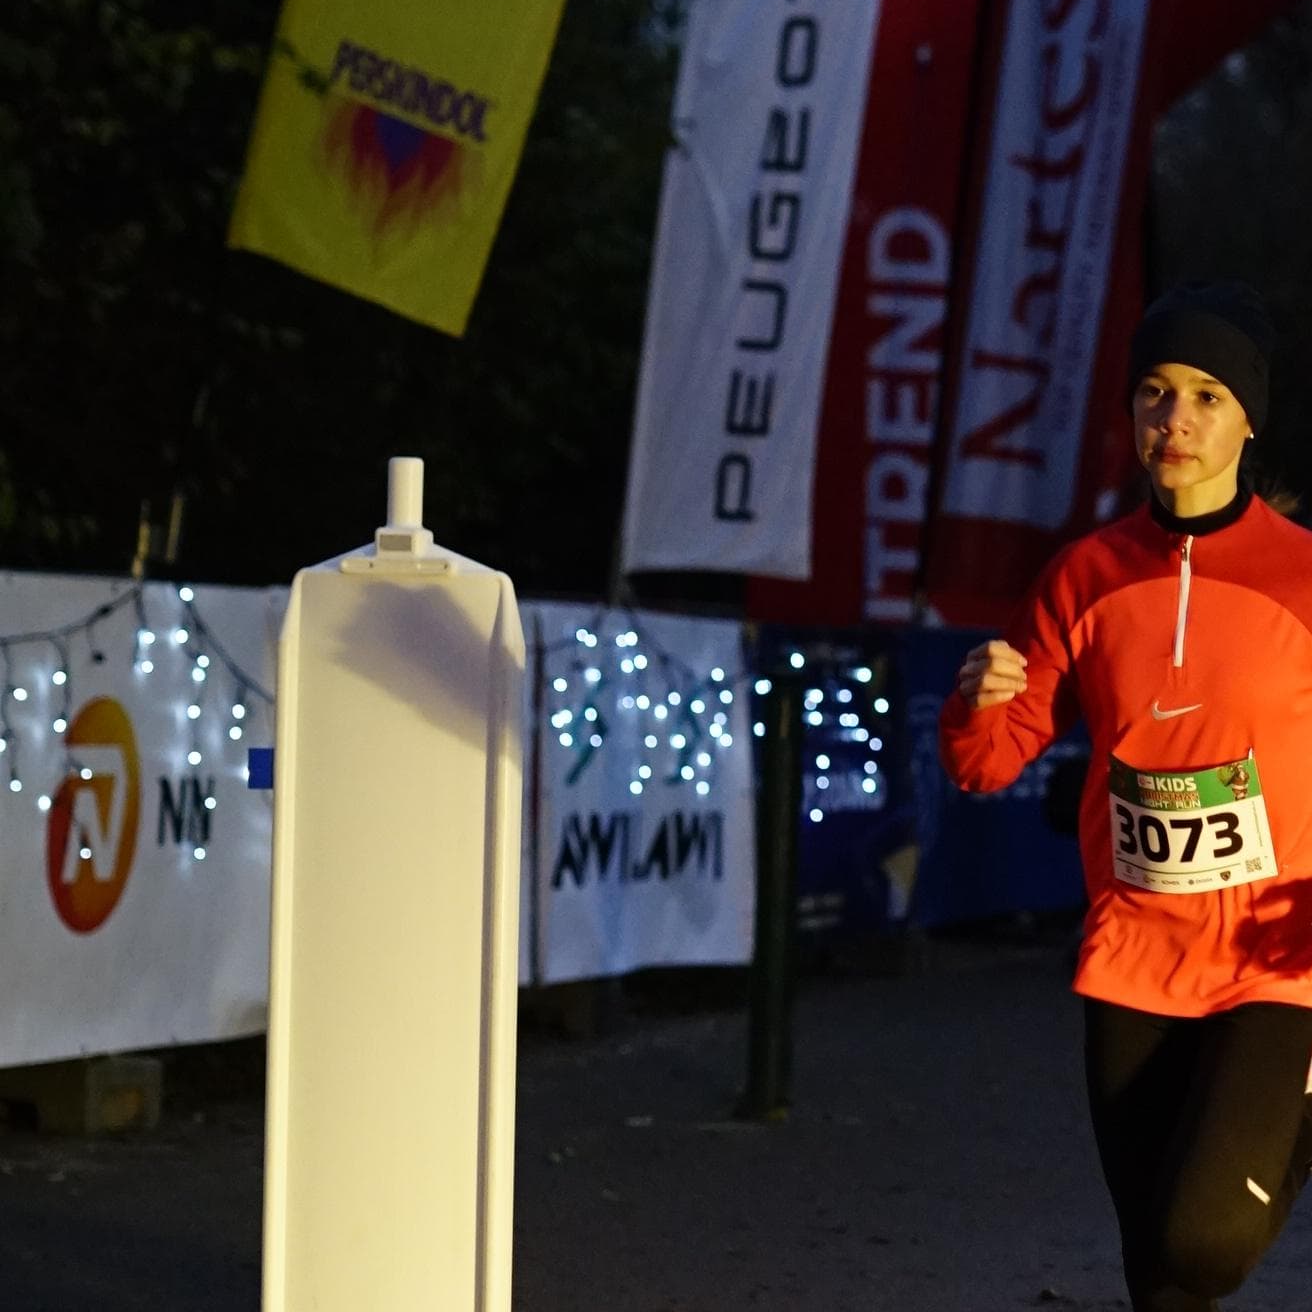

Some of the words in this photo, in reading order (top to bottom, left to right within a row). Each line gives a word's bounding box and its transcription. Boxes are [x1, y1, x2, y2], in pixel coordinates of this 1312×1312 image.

[329, 41, 490, 142] PERSKINDOL
[158, 775, 215, 848] NN
[1155, 776, 1197, 792] KIDS
[1116, 803, 1244, 863] 3073
